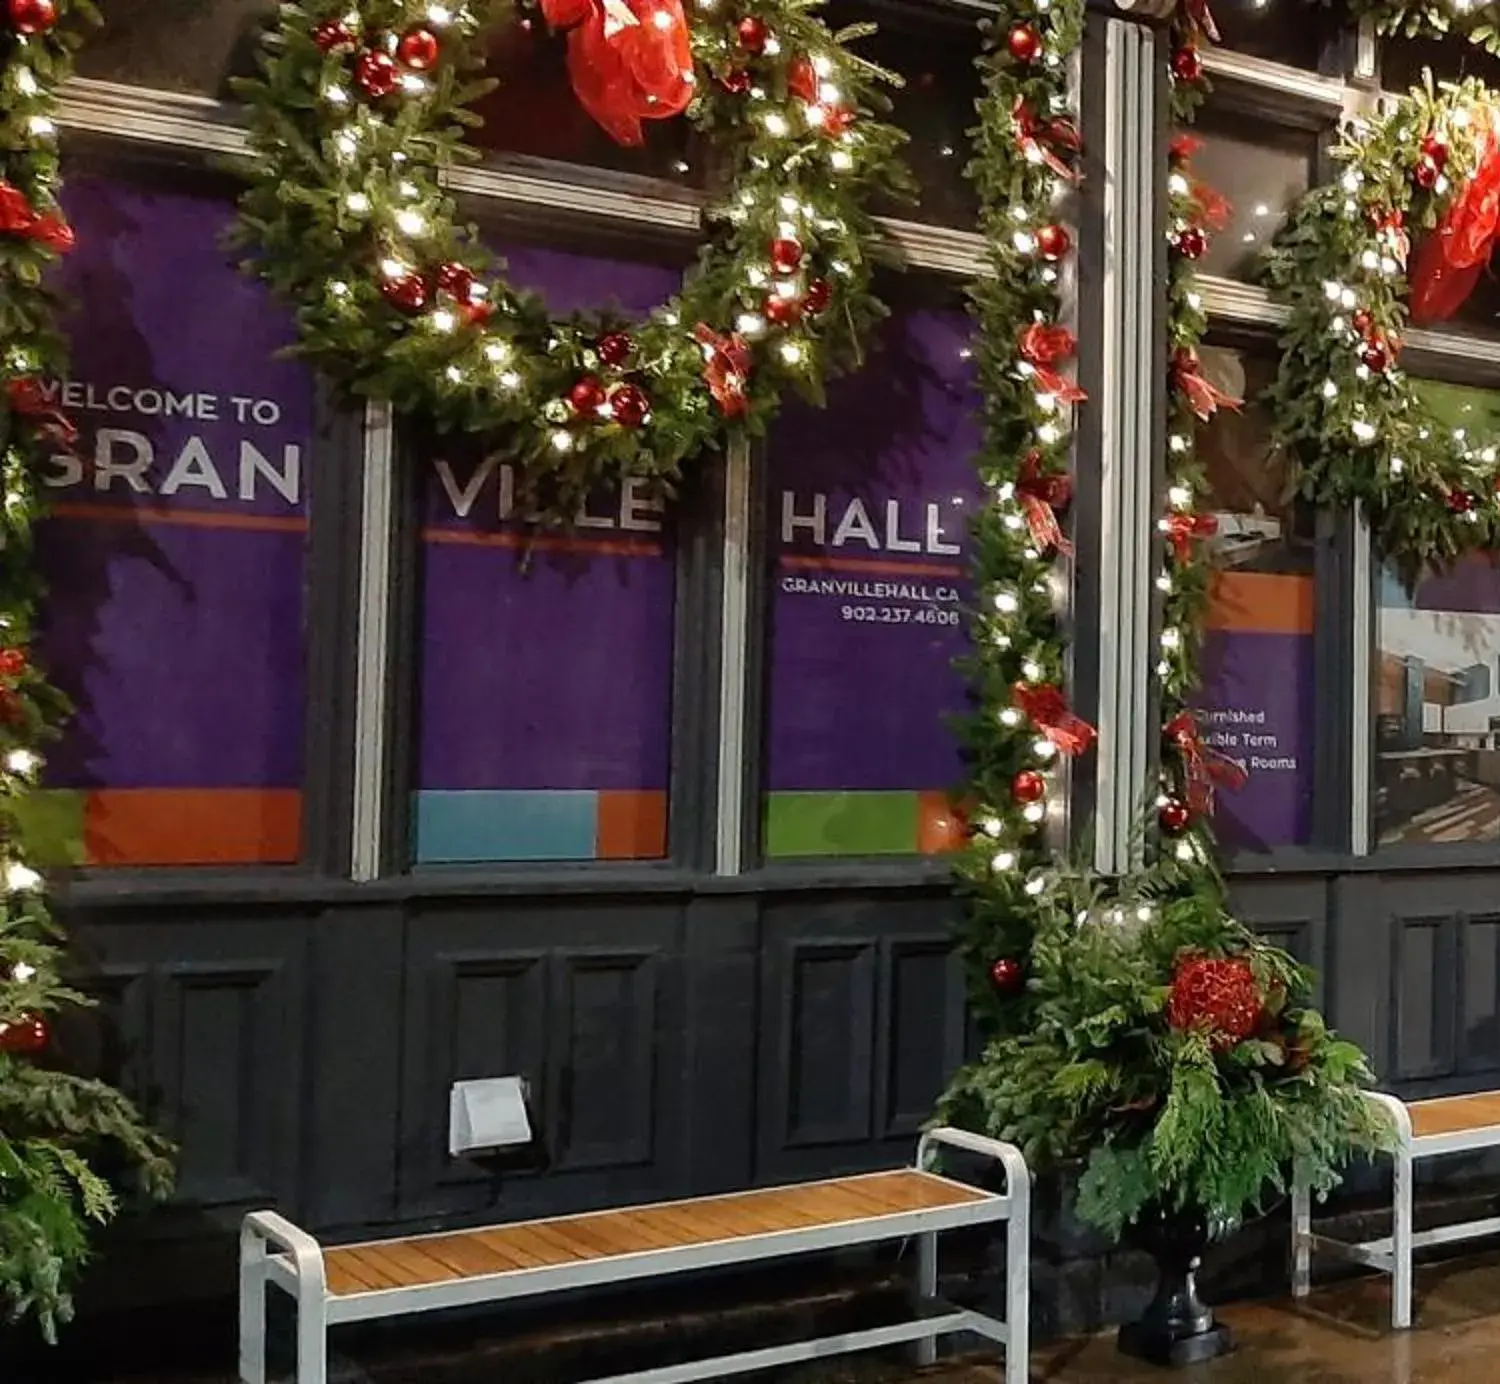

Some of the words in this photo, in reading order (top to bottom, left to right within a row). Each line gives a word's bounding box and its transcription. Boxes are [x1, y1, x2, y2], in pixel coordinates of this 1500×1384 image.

[231, 396, 281, 425] TO
[434, 456, 665, 531] VILE
[781, 490, 961, 555] HALL
[1242, 733, 1277, 748] Term
[1250, 755, 1297, 769] Rooms
